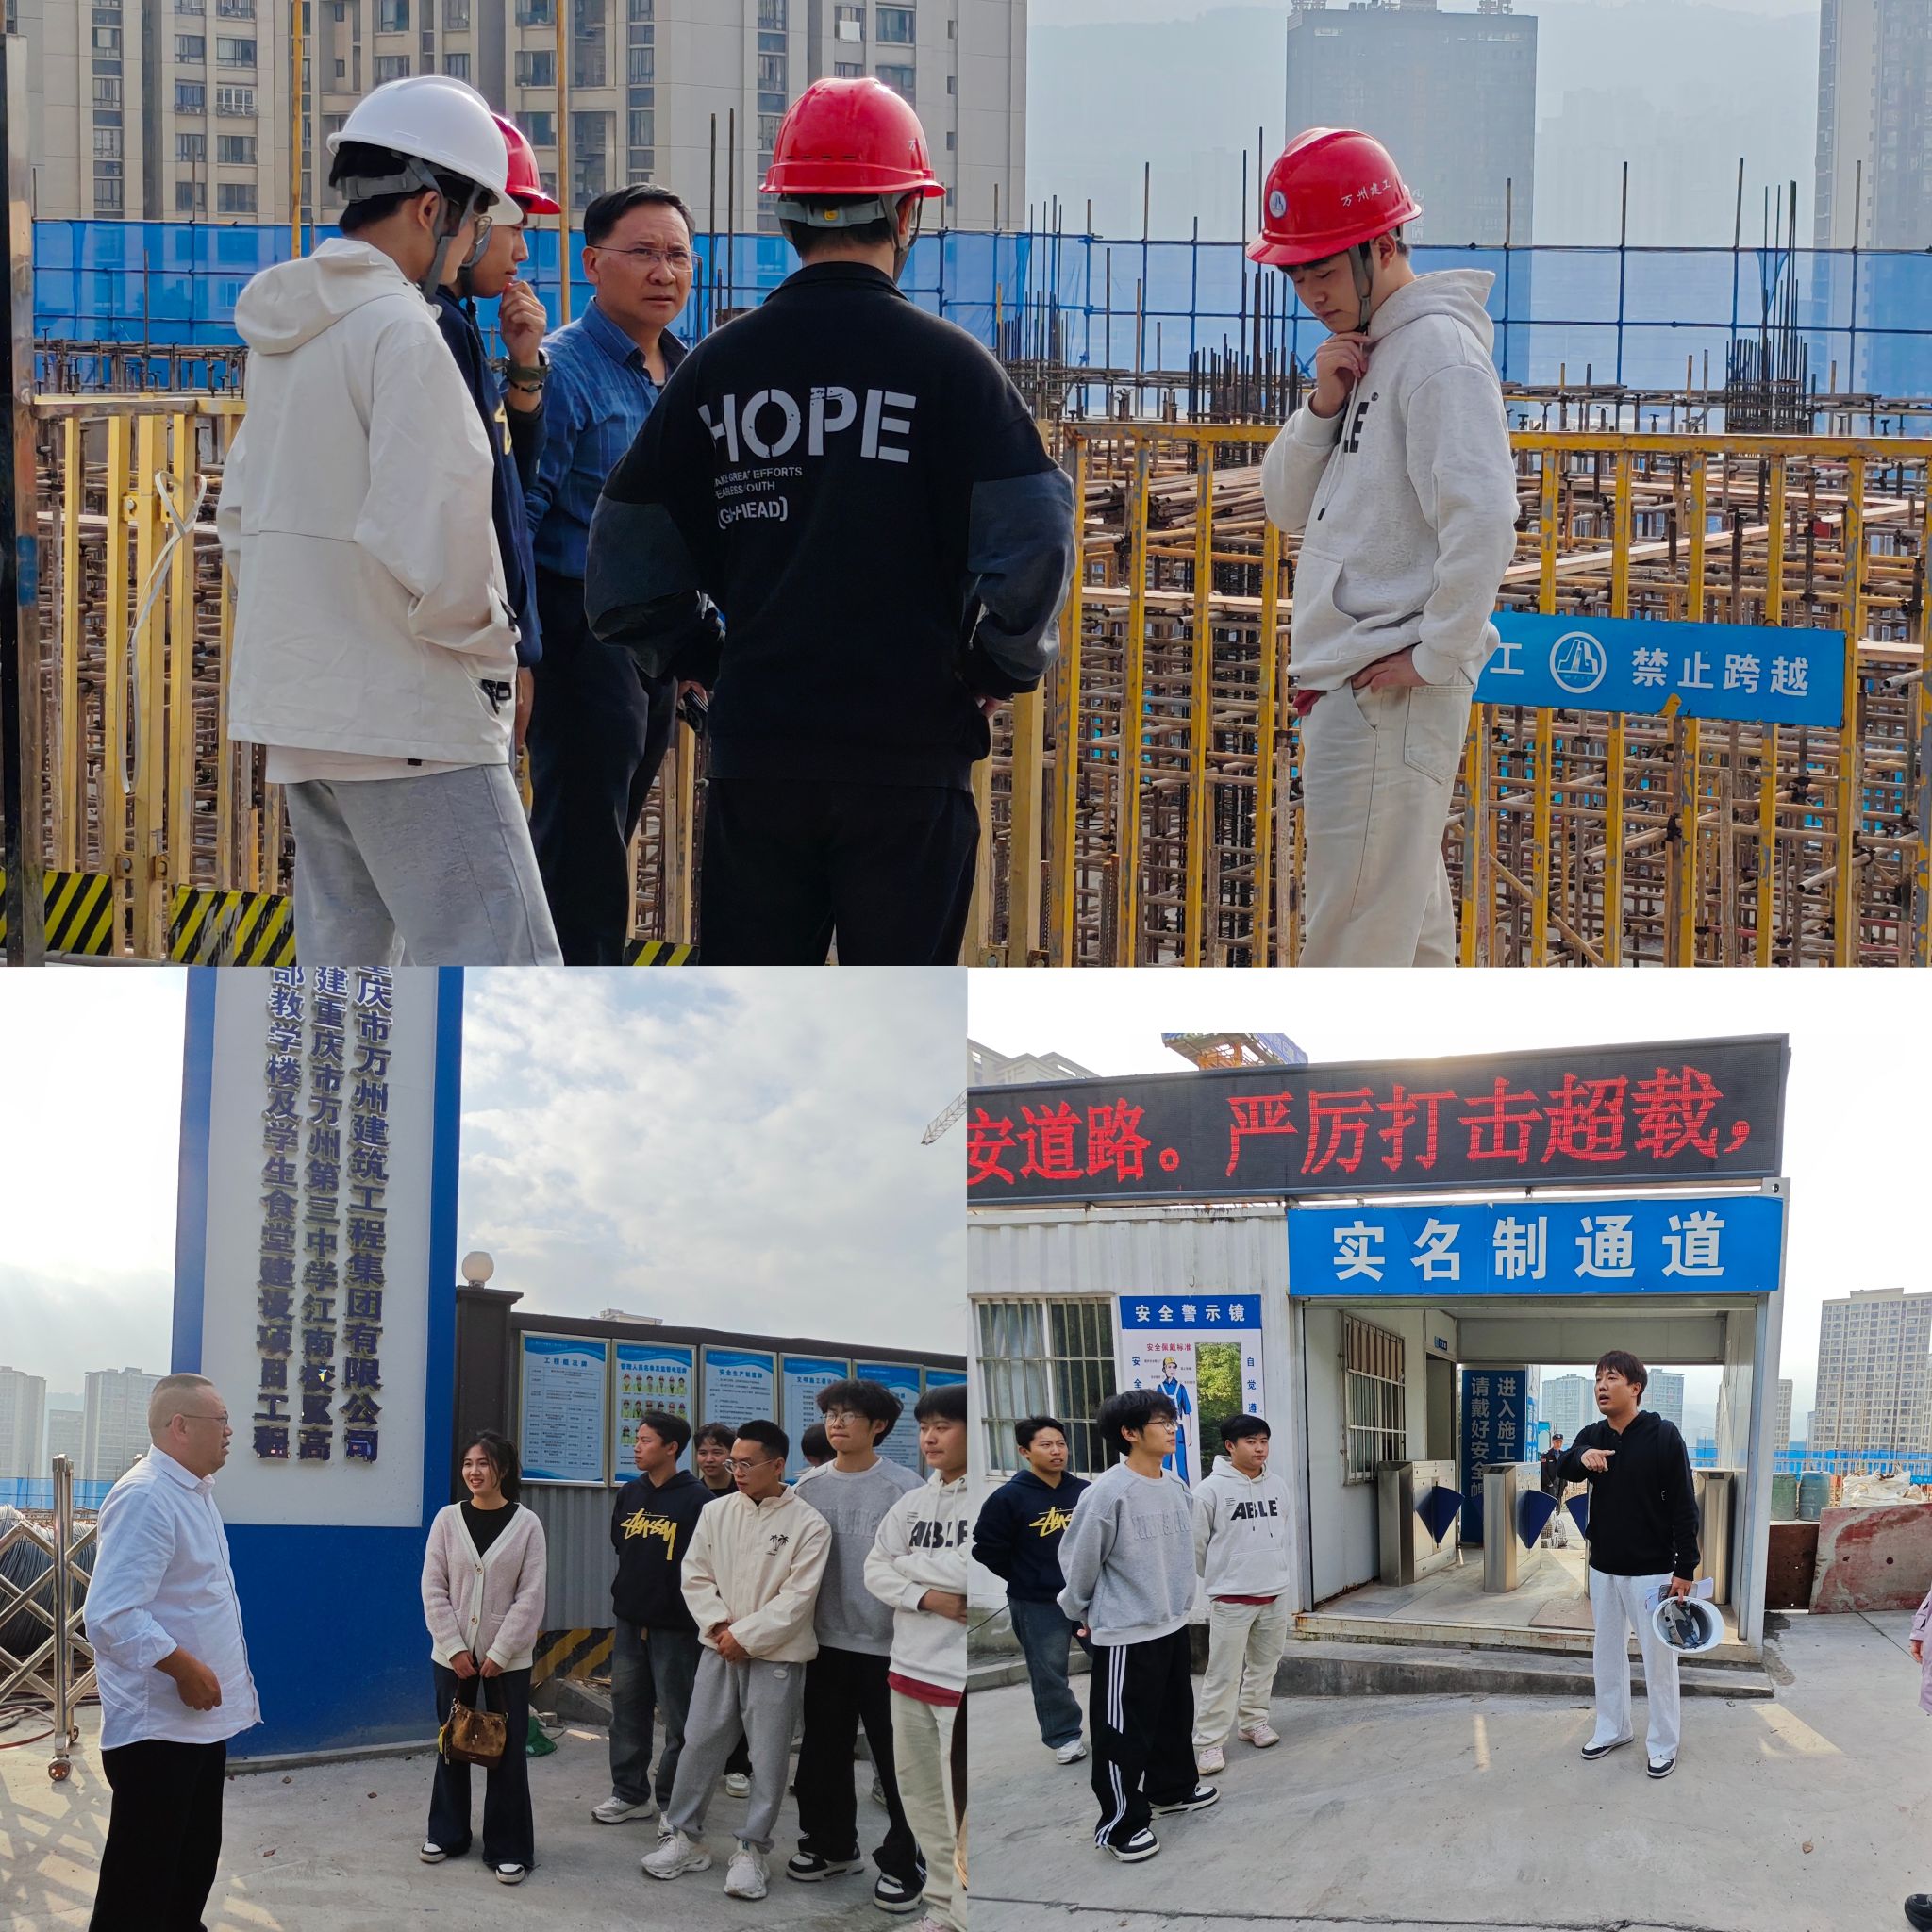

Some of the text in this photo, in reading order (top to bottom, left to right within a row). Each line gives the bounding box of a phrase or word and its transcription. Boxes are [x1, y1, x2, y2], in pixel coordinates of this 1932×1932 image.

[1340, 179, 1391, 207] 万州建工
[697, 386, 917, 463] HOPE
[753, 466, 803, 479] EFFORTS
[1631, 647, 1809, 697] 禁止跨越
[1333, 1210, 1725, 1283] 实名制通道
[1135, 1304, 1245, 1323] 安全警示镜
[1146, 1342, 1191, 1352] 安全佩戴标准
[1496, 1376, 1517, 1460] 进入施工
[1230, 1499, 1278, 1521] ABLE
